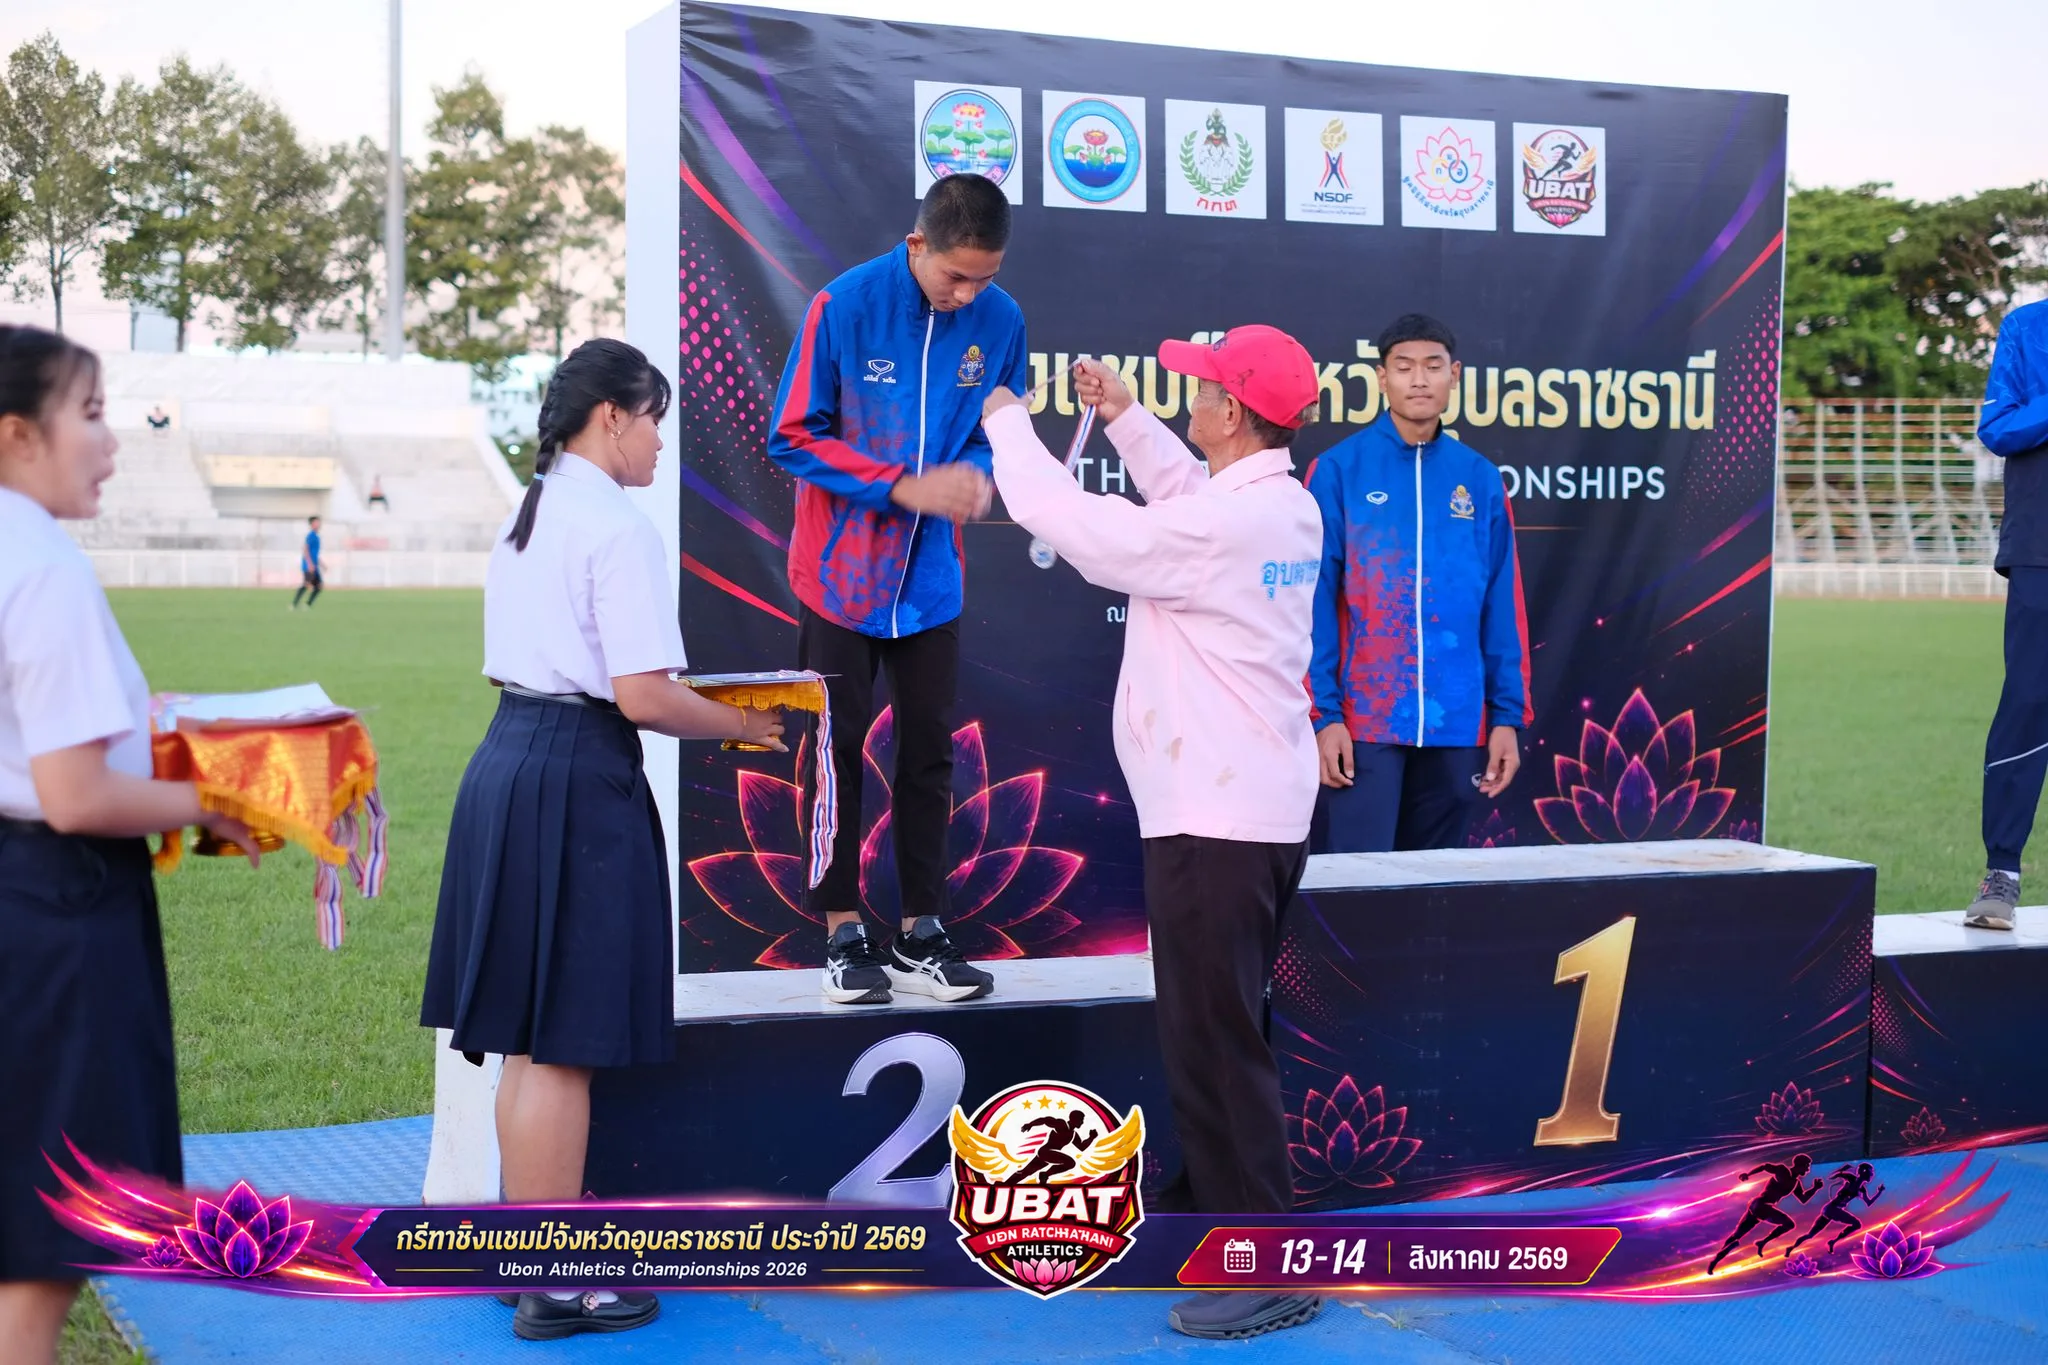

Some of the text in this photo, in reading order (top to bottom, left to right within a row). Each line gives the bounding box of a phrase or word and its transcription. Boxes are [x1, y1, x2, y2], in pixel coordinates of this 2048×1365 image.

[1314, 191, 1354, 203] NSDF
[1528, 179, 1592, 201] UBAT
[1534, 916, 1637, 1147] 1
[827, 1032, 966, 1207] 2
